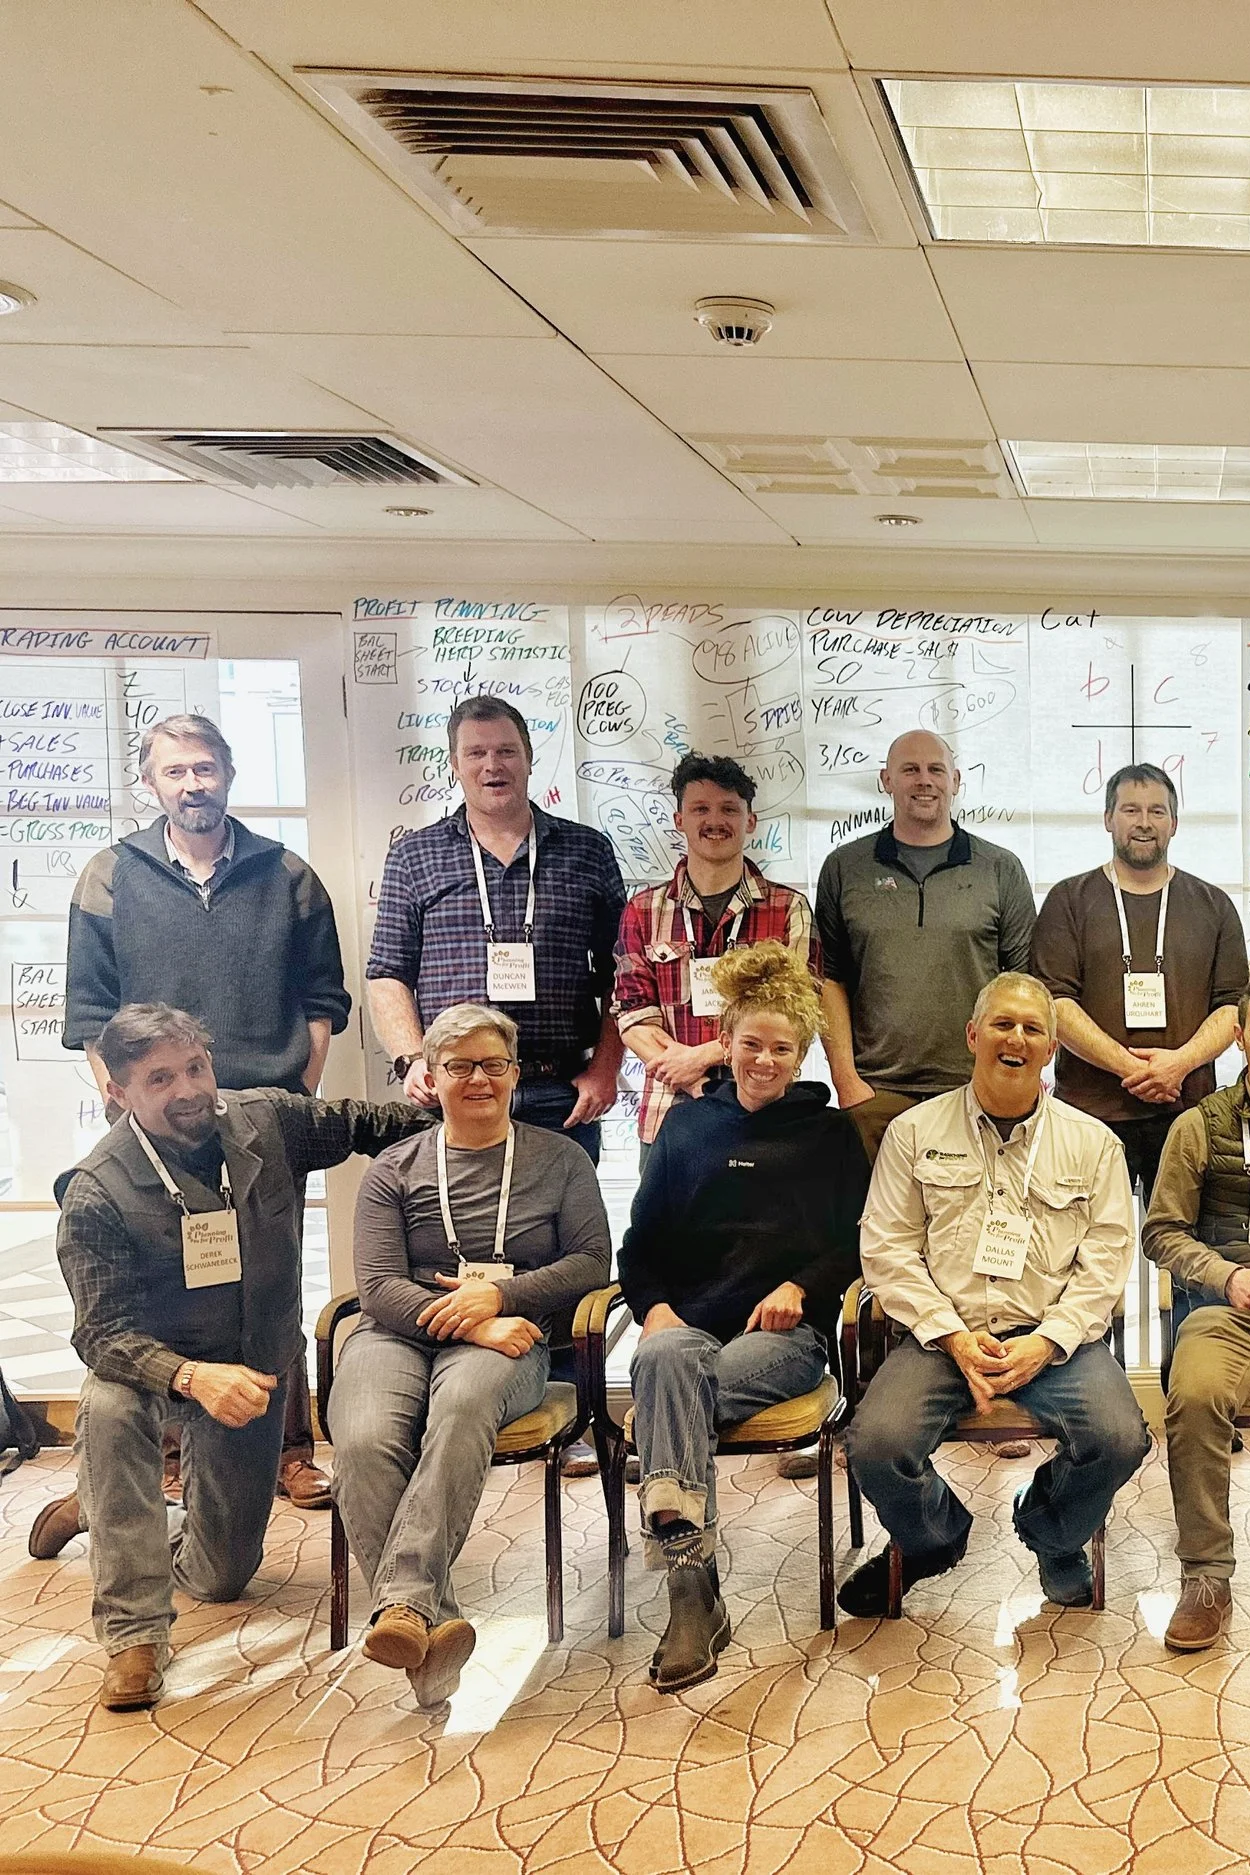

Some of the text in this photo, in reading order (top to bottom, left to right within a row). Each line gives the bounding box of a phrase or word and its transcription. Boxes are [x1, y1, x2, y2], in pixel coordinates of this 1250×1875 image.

[353, 597, 549, 621] PROFIT PLANNING
[1041, 607, 1101, 630] Cat
[807, 607, 1027, 636] COW DEPRECIATION
[0, 629, 210, 652] RADING ACCOUNT
[358, 635, 384, 648] BAL
[433, 627, 525, 648] BREEDING
[744, 627, 796, 662] ALIVE
[809, 629, 904, 659] PURCHASE
[355, 649, 393, 663] SHEET
[435, 648, 483, 663] HERD
[358, 664, 395, 678] START
[545, 676, 571, 690] CAS
[546, 692, 571, 707] FLO
[811, 694, 860, 725] YEARS
[583, 699, 632, 721] PREG
[398, 712, 450, 730] LIVEST
[586, 717, 634, 736] COWS
[396, 744, 450, 766] TRADI
[399, 784, 454, 805] GROSS
[10, 819, 110, 842] GROSS PROD
[830, 806, 893, 843] ANNUAL
[18, 967, 58, 985] BAL
[200, 1250, 223, 1260] DEREK
[985, 1245, 1015, 1256] DALLAS
[186, 1257, 238, 1271] SCHWANEBECK
[982, 1255, 1014, 1267] MOUNT
